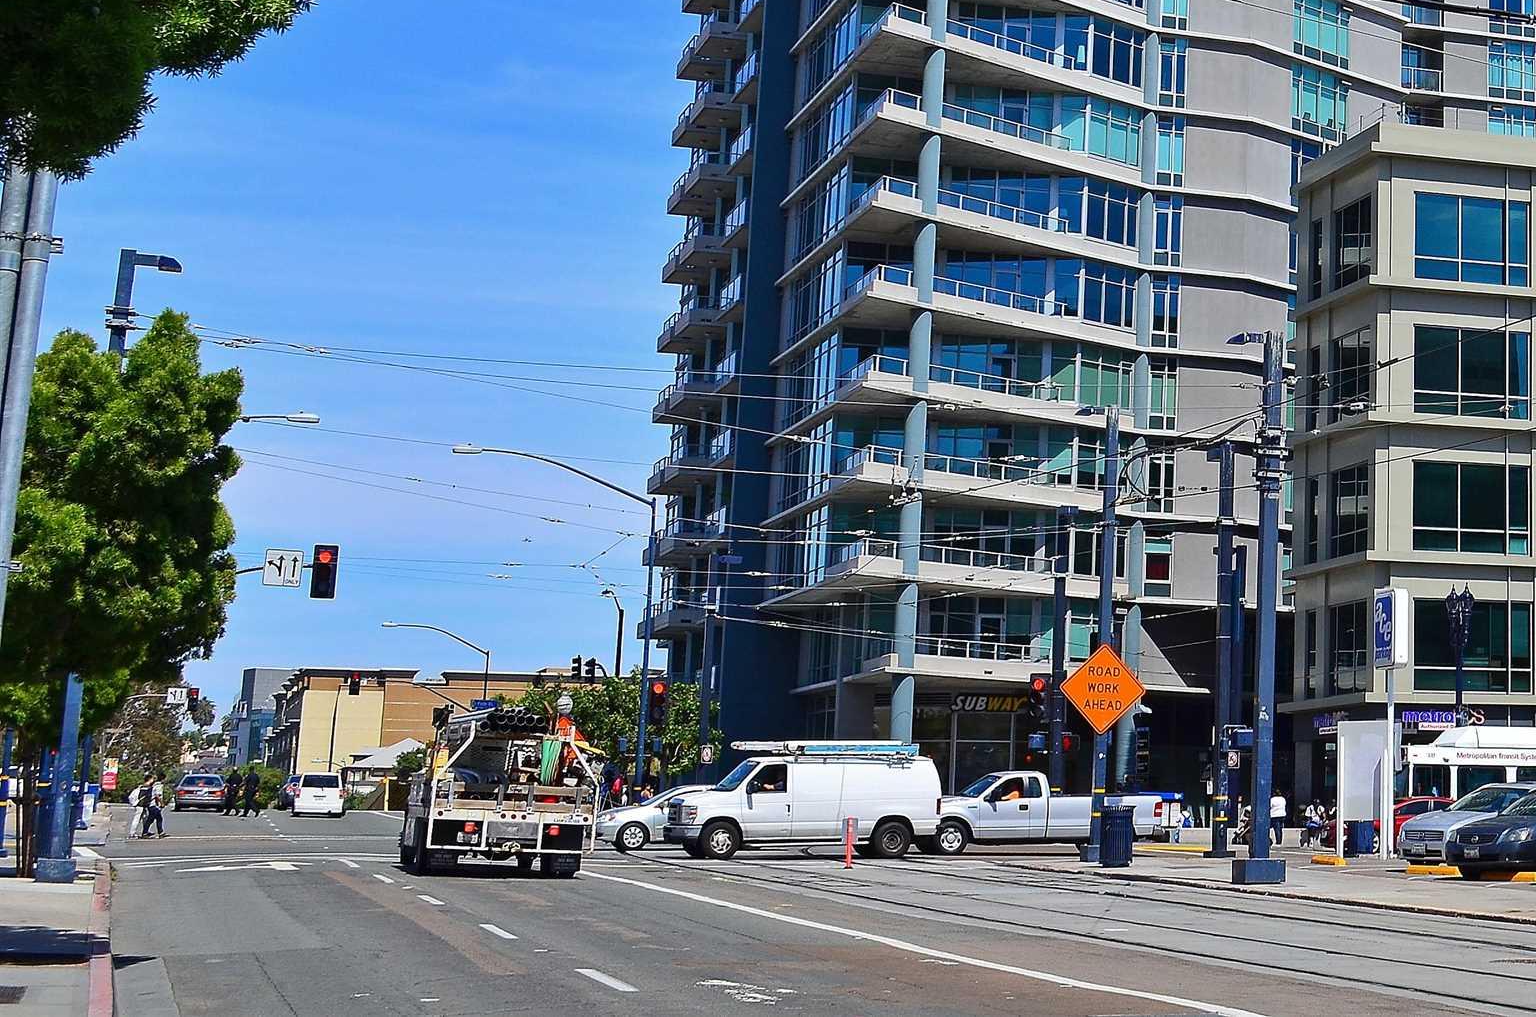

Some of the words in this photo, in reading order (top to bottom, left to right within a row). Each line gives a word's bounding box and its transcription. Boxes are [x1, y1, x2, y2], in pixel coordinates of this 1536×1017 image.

[1088, 666, 1120, 677] ROAD
[1088, 683, 1119, 693] WORK
[952, 696, 1028, 712] SUBWAY
[1084, 700, 1121, 711] AHEAD
[1456, 752, 1497, 760] Metropolitan
